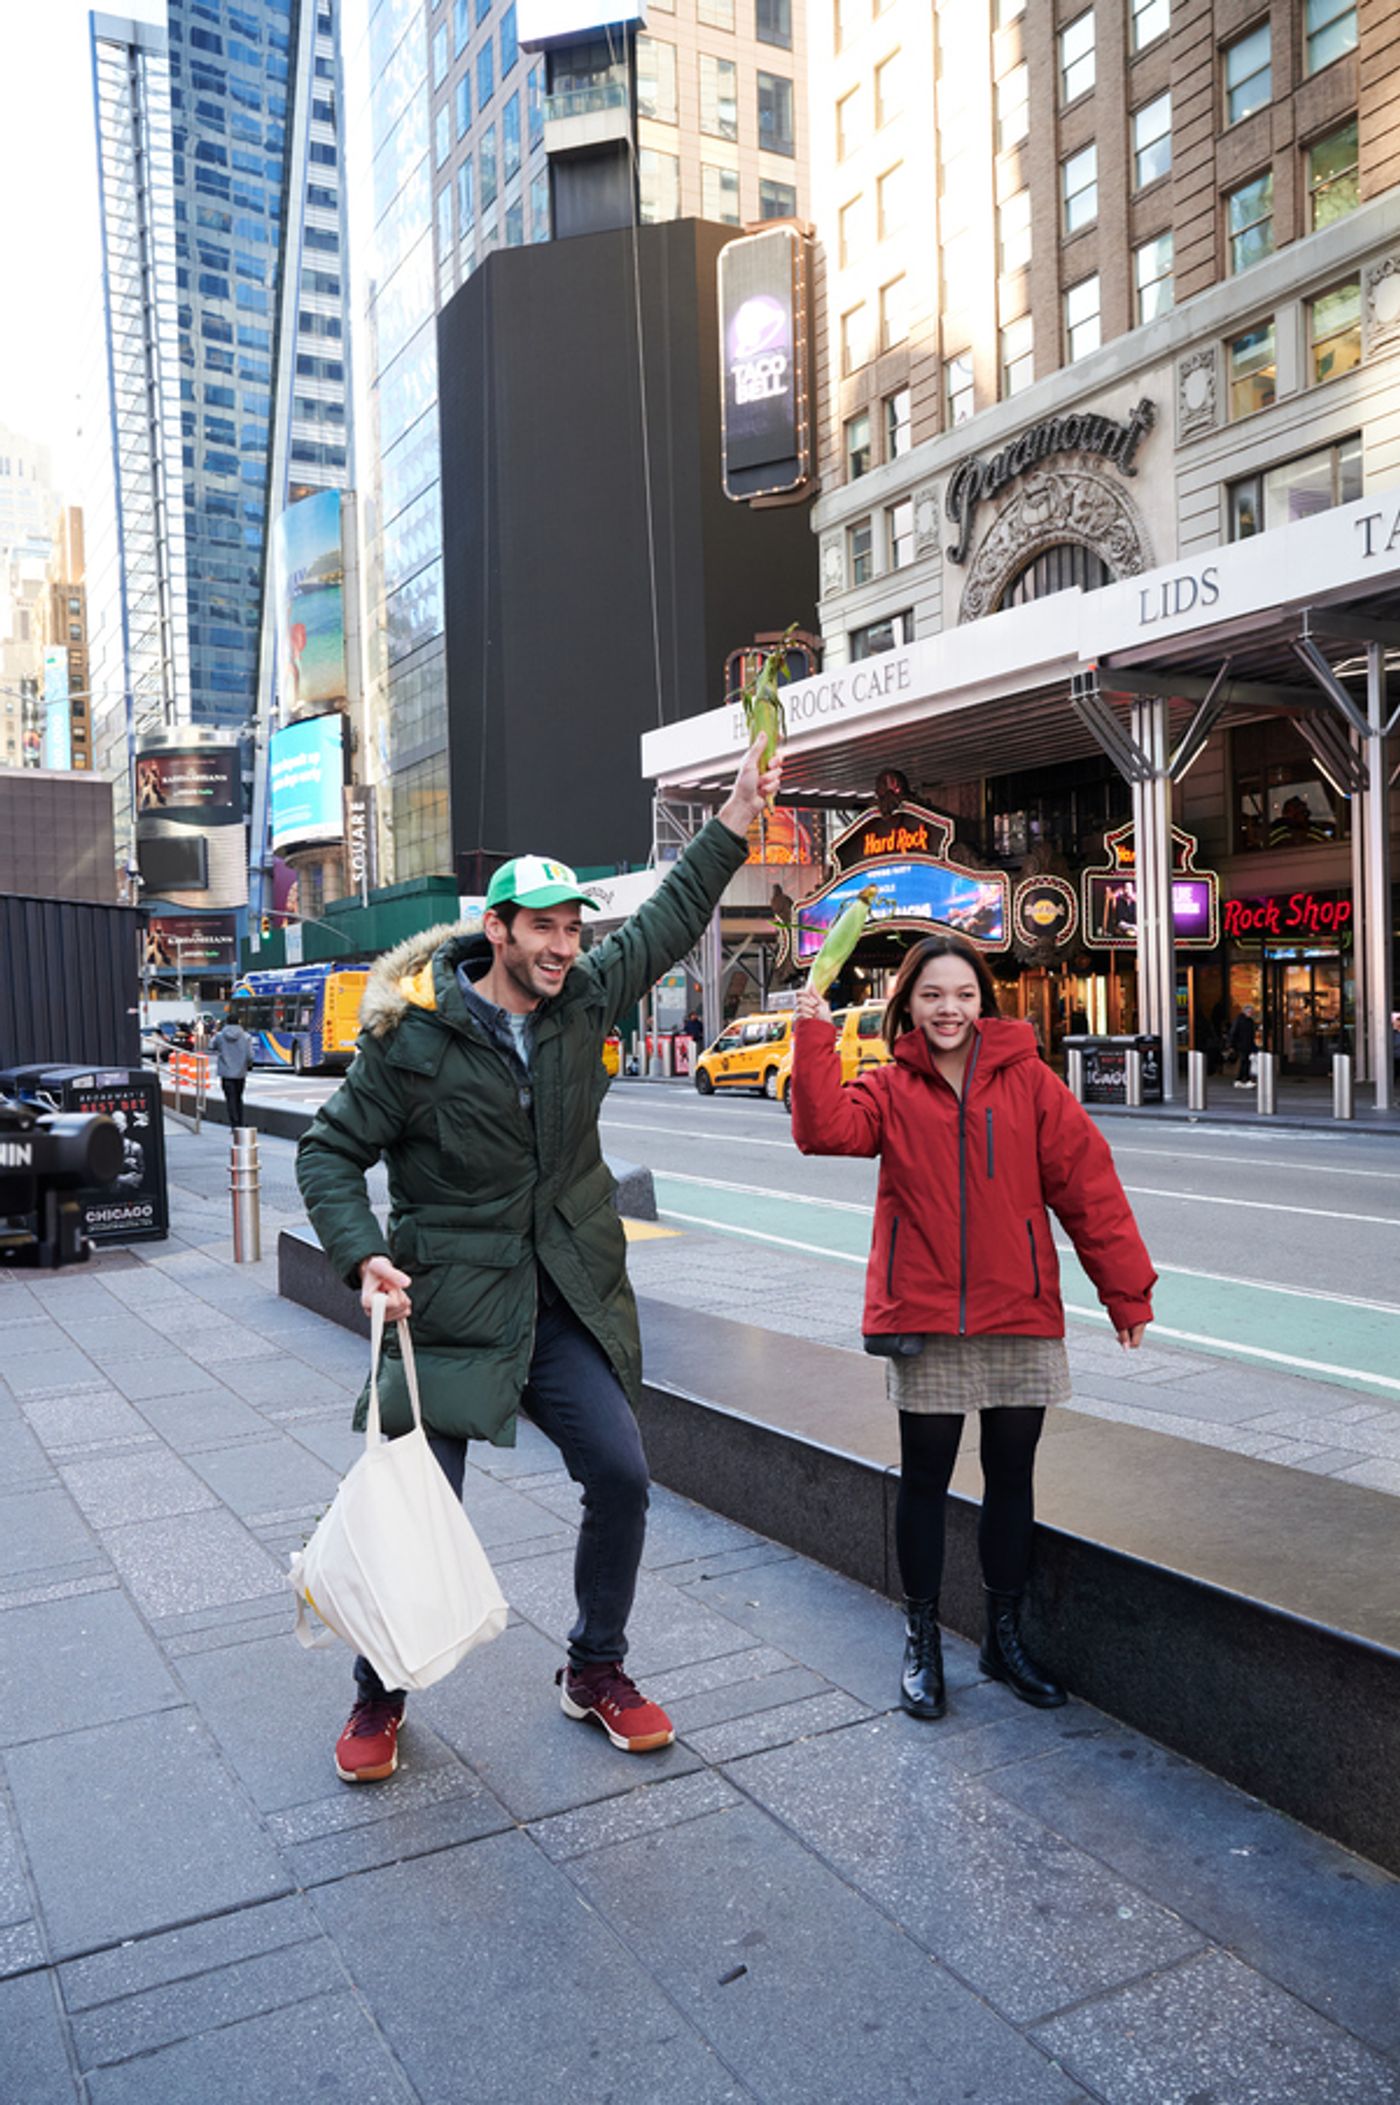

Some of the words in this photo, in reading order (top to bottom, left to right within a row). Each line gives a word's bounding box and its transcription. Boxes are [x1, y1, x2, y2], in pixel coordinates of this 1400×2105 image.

[731, 354, 787, 384] TACO
[736, 371, 788, 405] BELL
[945, 398, 1156, 565] Paramount
[1139, 566, 1220, 626] LIDS
[789, 680, 846, 722] ROCK
[851, 659, 911, 703] CAFE
[352, 802, 366, 882] SQUARE
[864, 828, 895, 856] Hard
[896, 822, 928, 857] Rock
[1224, 899, 1280, 936] Rock
[1286, 893, 1352, 932] Shop
[80, 1101, 115, 1113] BEST
[121, 1098, 146, 1111] BET
[86, 1204, 154, 1223] CHICAGO
